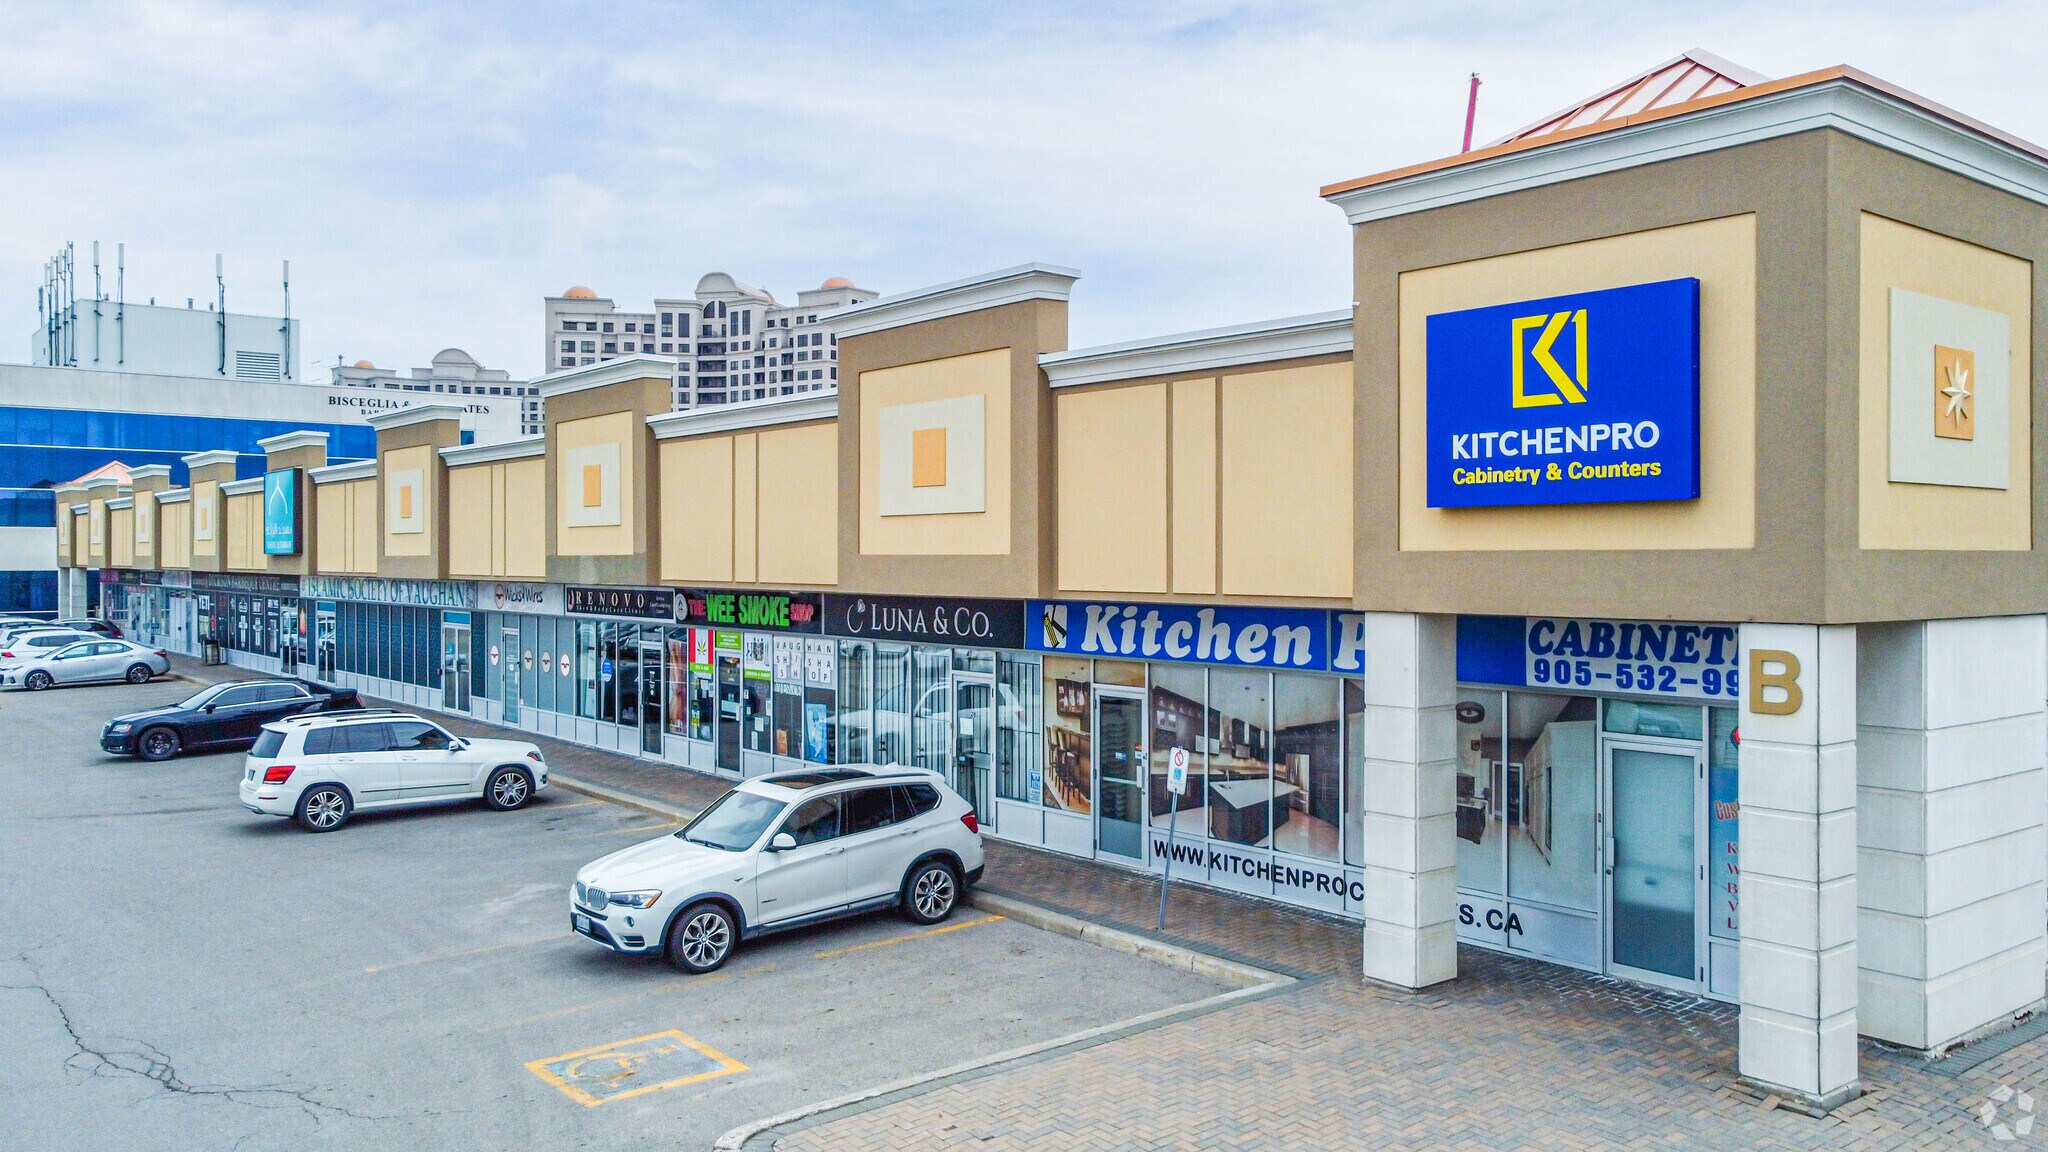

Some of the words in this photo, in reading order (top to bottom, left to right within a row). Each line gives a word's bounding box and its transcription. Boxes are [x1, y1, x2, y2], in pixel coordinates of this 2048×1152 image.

[328, 396, 398, 409] BISCEGLIA
[1452, 420, 1660, 460] KITCHENPRO
[1452, 464, 1541, 485] Cabinetry
[1546, 463, 1562, 481] &
[1568, 459, 1662, 481] Counters
[308, 577, 347, 599] ISLAMIC
[350, 578, 388, 601] SOCIETY
[390, 579, 404, 603] OF
[405, 580, 465, 607] VAUGHAN
[575, 591, 645, 609] RENOVO
[687, 598, 706, 616] THE
[706, 594, 735, 623] WEE
[738, 595, 790, 627] SMOKE
[790, 603, 814, 622] SHOP
[871, 604, 928, 634] LUNA
[933, 606, 950, 635] &
[1081, 604, 1312, 667] Kitchen
[1528, 619, 1739, 666] CABINET
[1749, 648, 1803, 715] B
